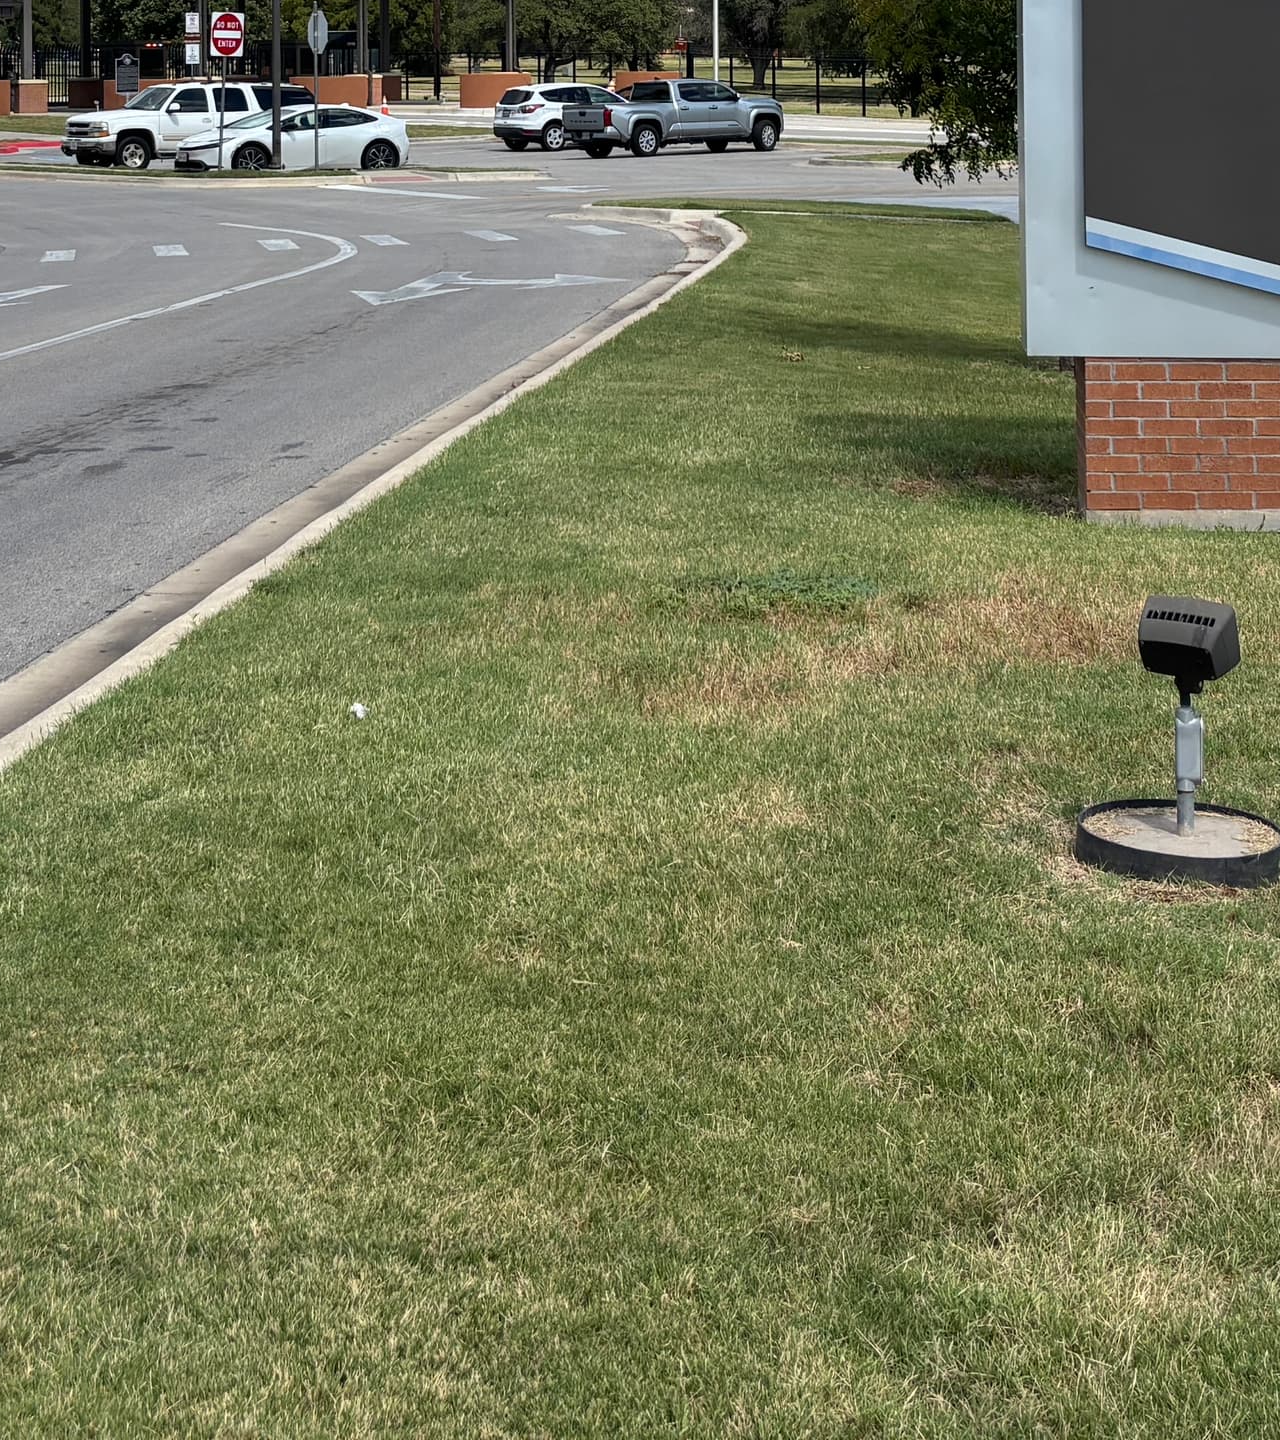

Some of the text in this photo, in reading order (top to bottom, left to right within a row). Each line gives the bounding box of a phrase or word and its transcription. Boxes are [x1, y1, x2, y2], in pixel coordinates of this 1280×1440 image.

[216, 21, 239, 30] DO NOT
[217, 40, 236, 48] ENTER
